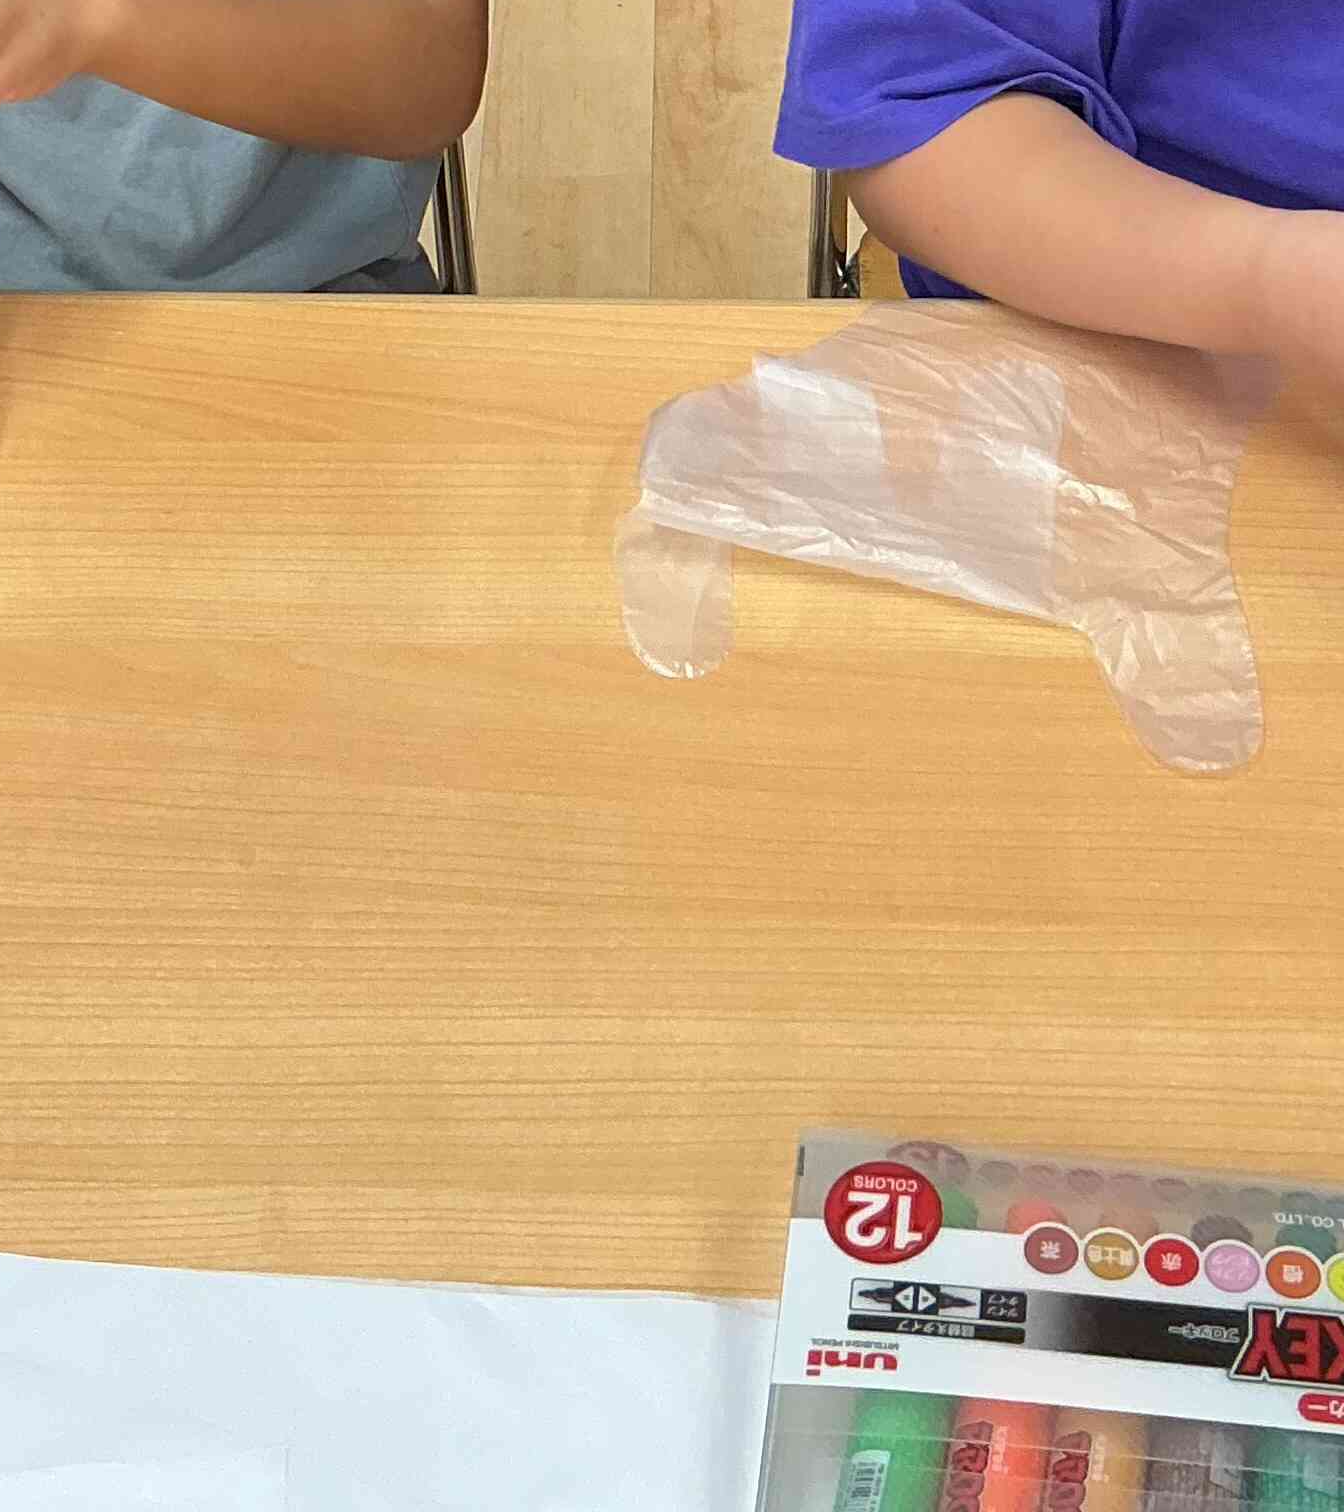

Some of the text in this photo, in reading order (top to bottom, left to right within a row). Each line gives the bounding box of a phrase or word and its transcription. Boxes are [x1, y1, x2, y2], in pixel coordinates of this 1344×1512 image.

[854, 1175, 917, 1192] COLORS
[845, 1192, 924, 1250] 12
[1038, 1240, 1061, 1260] 茶
[1161, 1252, 1183, 1273] 赤
[805, 1350, 899, 1377] uni
